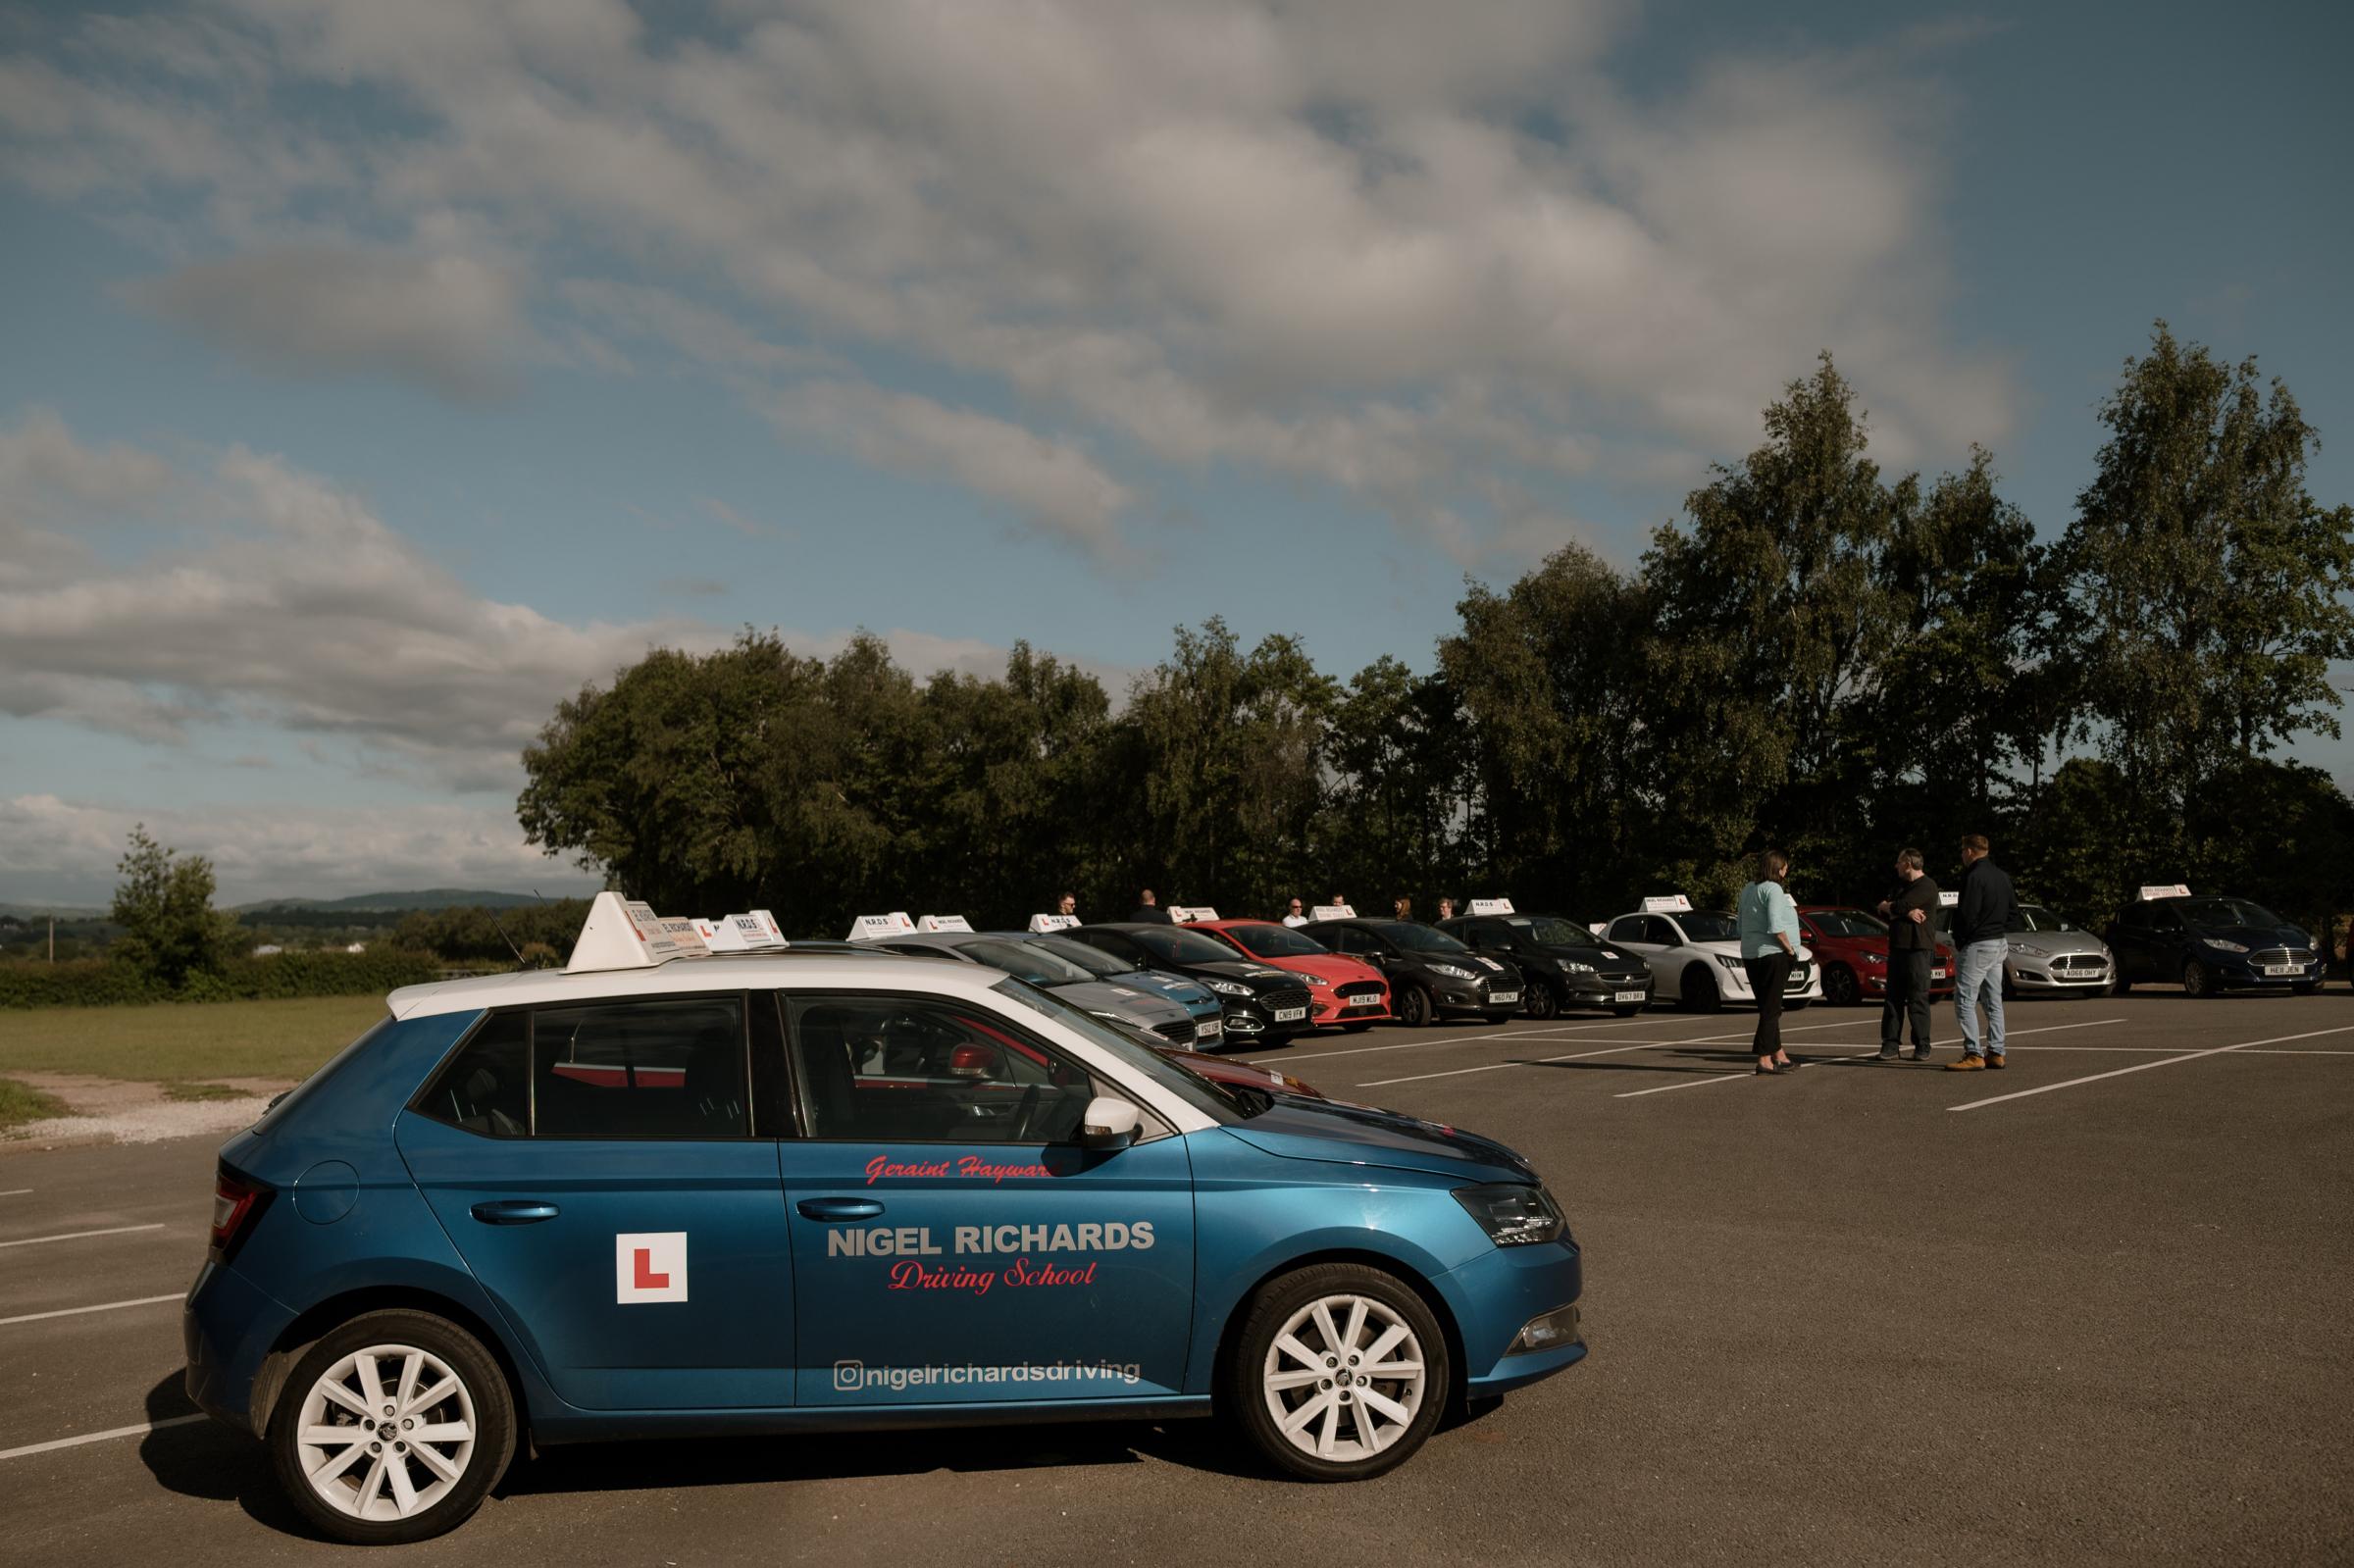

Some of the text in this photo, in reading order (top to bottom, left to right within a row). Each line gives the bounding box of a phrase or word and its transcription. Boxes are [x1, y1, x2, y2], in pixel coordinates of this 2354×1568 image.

[865, 1155, 950, 1186] Geraint
[828, 1221, 1155, 1257] NIGEL RICHARDS
[634, 1248, 670, 1290] L
[888, 1258, 1098, 1296] Driving School
[866, 1359, 1141, 1391] nigelrichardsdriving
